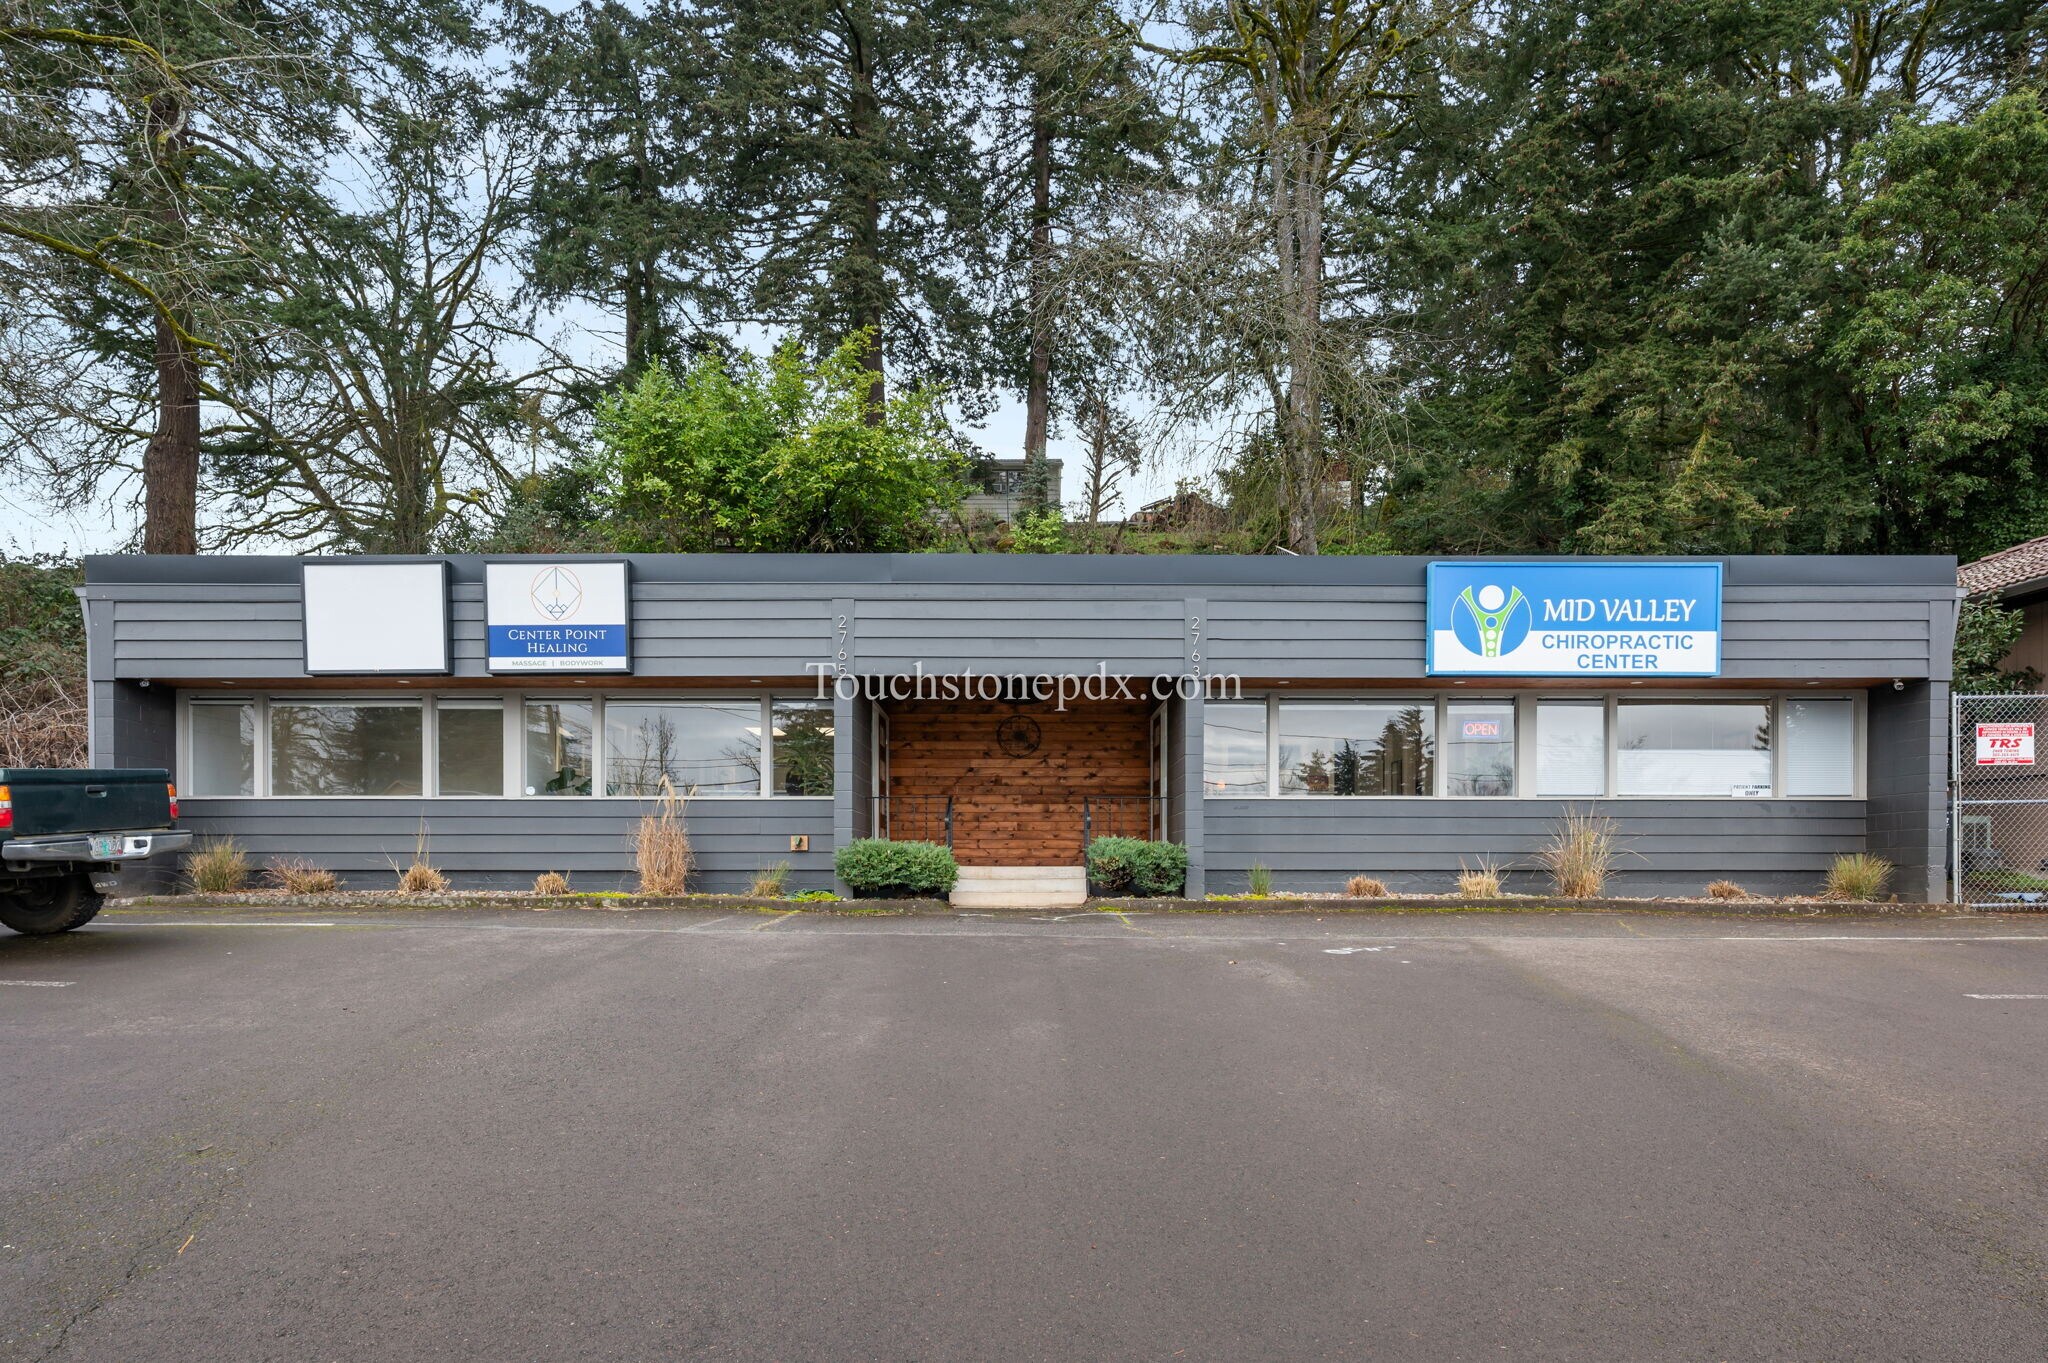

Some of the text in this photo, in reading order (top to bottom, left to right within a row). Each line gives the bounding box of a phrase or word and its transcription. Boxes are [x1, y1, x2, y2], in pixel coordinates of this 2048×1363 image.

[1543, 599, 1697, 622] MID VALLEY
[508, 629, 607, 640] CENTER POINT
[1542, 634, 1694, 650] CHIROPRACTIC
[527, 642, 588, 654] HEALING
[838, 614, 848, 676] 2765
[1191, 616, 1201, 678] 2763
[1577, 654, 1658, 669] CENTER
[1464, 723, 1499, 736] OPEN
[1989, 738, 2023, 748] TRS
